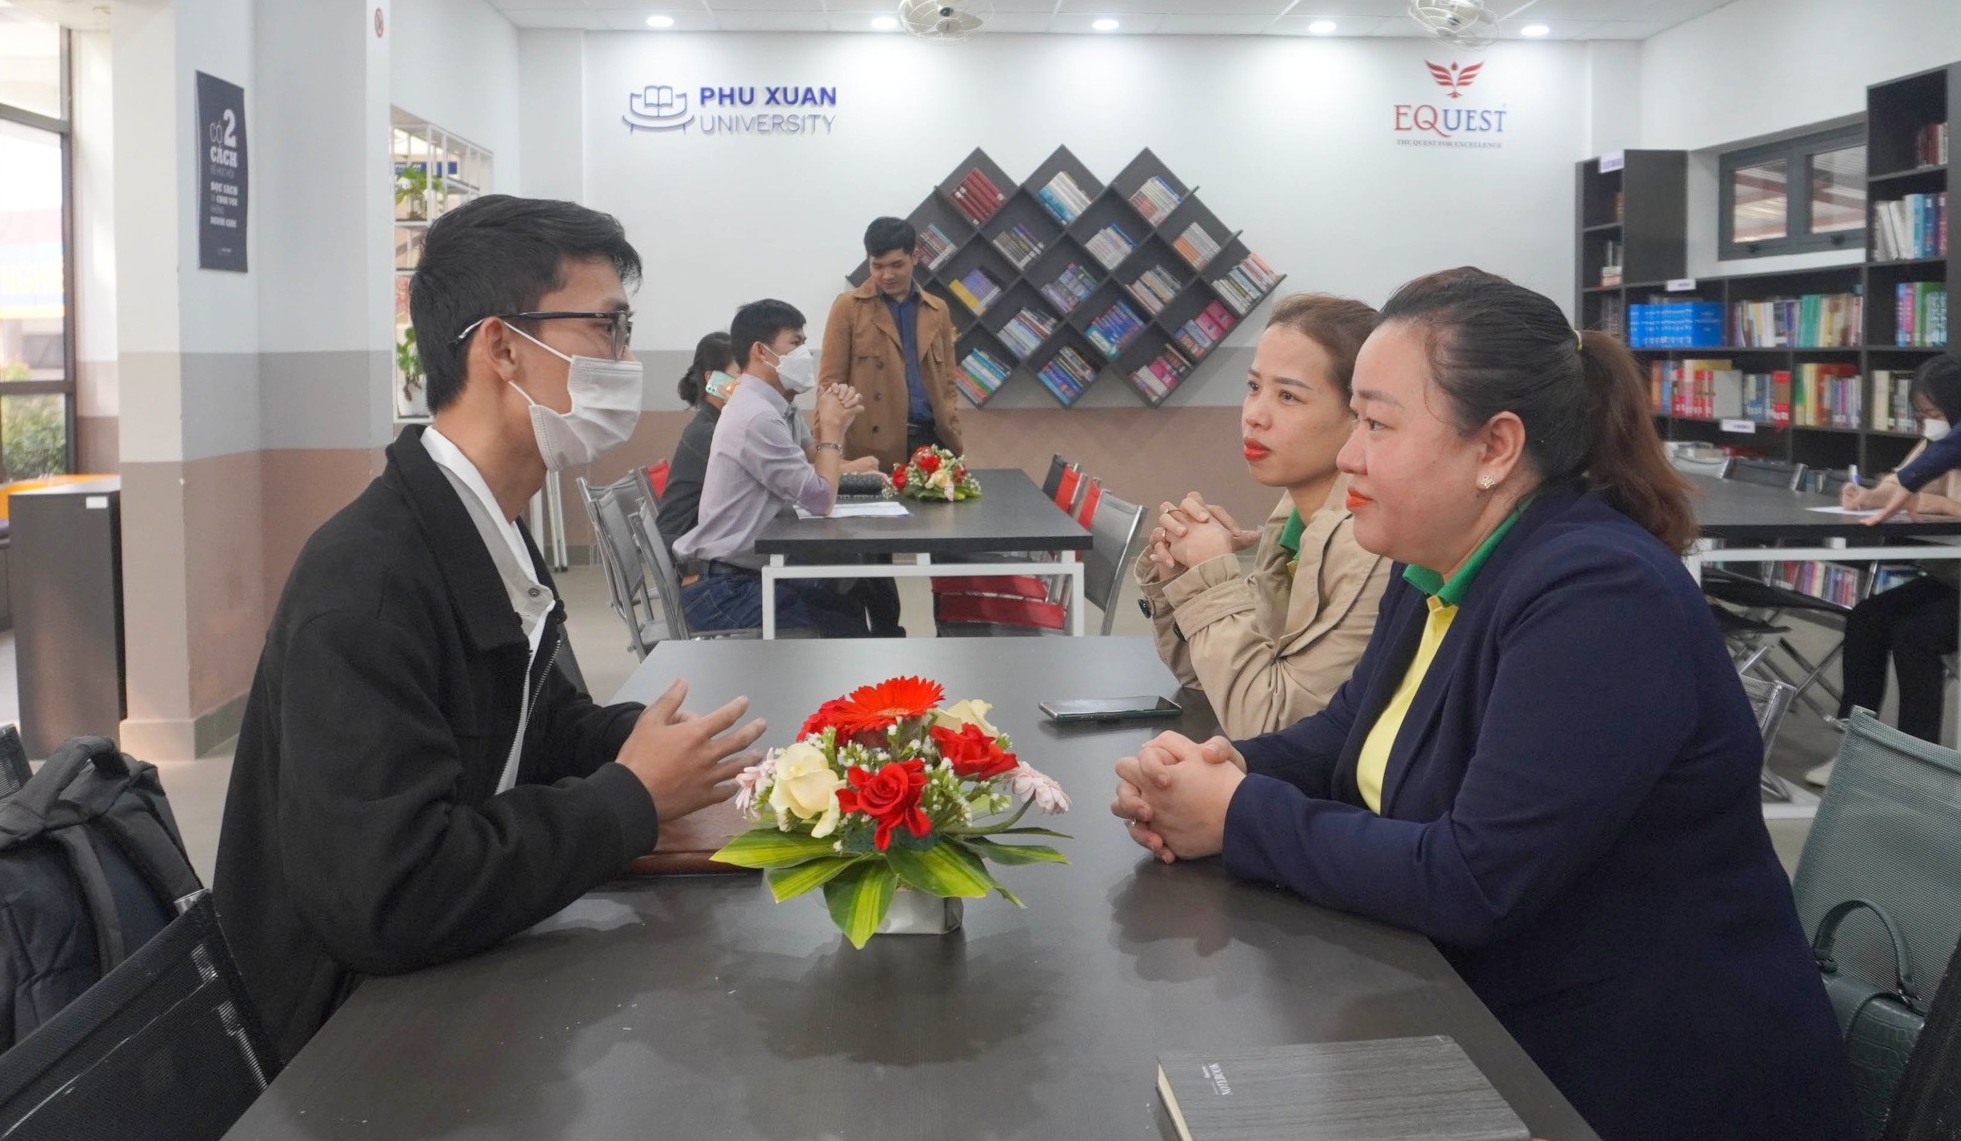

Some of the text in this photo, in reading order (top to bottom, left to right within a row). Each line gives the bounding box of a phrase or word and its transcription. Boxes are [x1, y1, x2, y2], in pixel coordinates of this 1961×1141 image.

[700, 86, 837, 106] PHU XUAN
[223, 108, 236, 148] 2
[700, 113, 837, 134] UNIVERSITY
[1393, 104, 1507, 138] EQUEST
[1397, 138, 1502, 149] THE QUEST FOR EXCELLENCE
